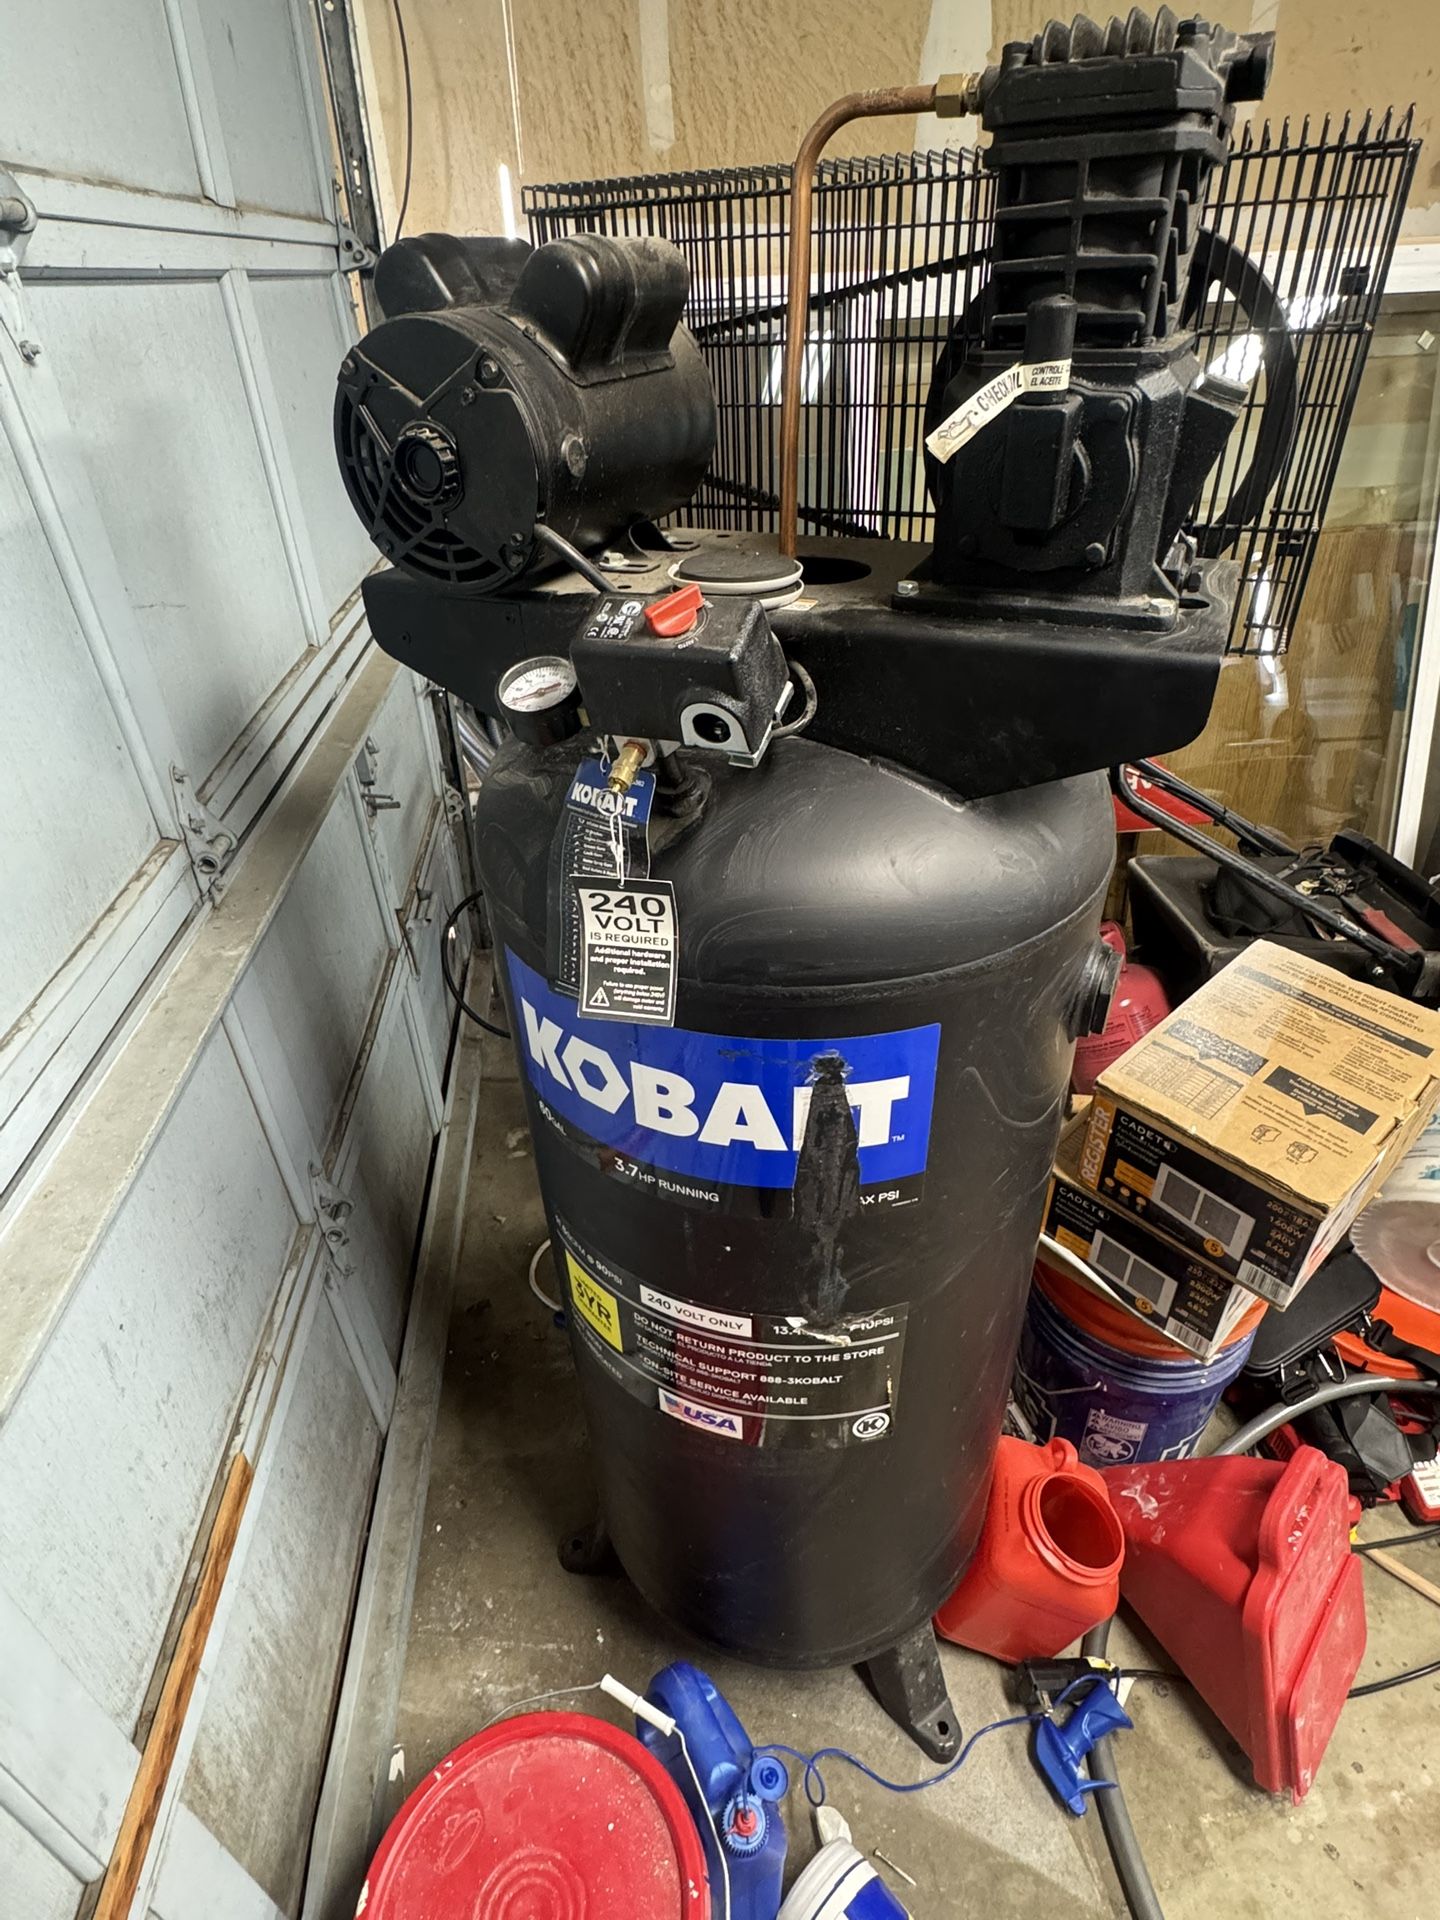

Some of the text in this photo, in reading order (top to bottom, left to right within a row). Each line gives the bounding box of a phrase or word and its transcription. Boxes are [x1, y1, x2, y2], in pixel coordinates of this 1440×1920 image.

[588, 892, 666, 917] 240
[594, 914, 664, 933] VOLT
[590, 932, 669, 946] IS REQUIRED
[594, 946, 666, 959] Additional hardware
[604, 957, 629, 965] proper
[630, 958, 670, 968] installation
[613, 967, 646, 976] required.
[1120, 1115, 1163, 1144] CADET
[659, 1178, 720, 1203] RUNNING
[878, 1190, 900, 1203] PSI
[1058, 1186, 1099, 1213] CADET
[647, 1293, 744, 1330] 240 VOLT ONLY
[633, 1312, 886, 1363] DO NOT RETURN PRODUCT TO THE STORE
[636, 1333, 843, 1385] TECHNICAL SUPPORT 888-3KOBALT
[746, 1359, 772, 1367] TIENDA
[689, 1377, 740, 1398] SERVICE
[742, 1392, 809, 1405] AVAILABLE
[683, 1405, 737, 1433] USA
[1102, 1415, 1142, 1430] WARNING
[1105, 1423, 1130, 1434] AVISO
